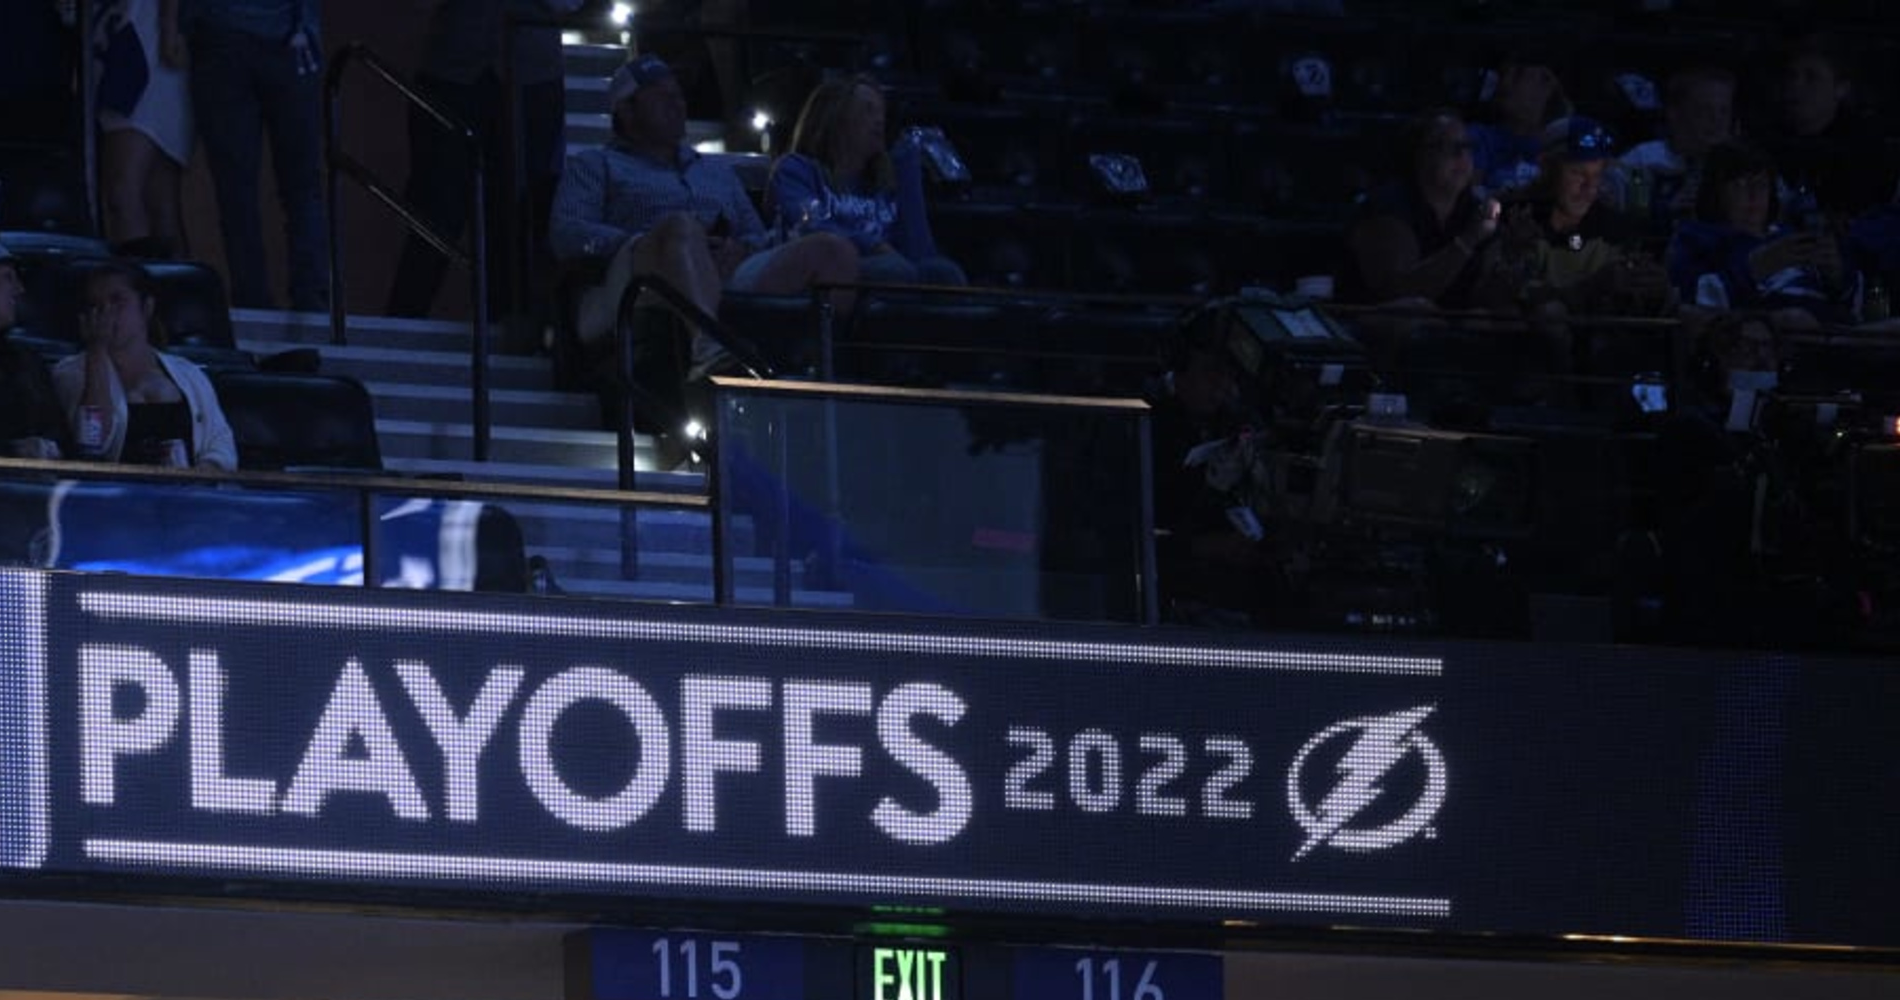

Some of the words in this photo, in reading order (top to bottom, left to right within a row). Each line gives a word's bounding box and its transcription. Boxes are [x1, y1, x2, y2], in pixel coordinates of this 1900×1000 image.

[77, 641, 974, 845] PLAYOFFS
[1004, 726, 1255, 820] 2022
[652, 938, 742, 1000] 115
